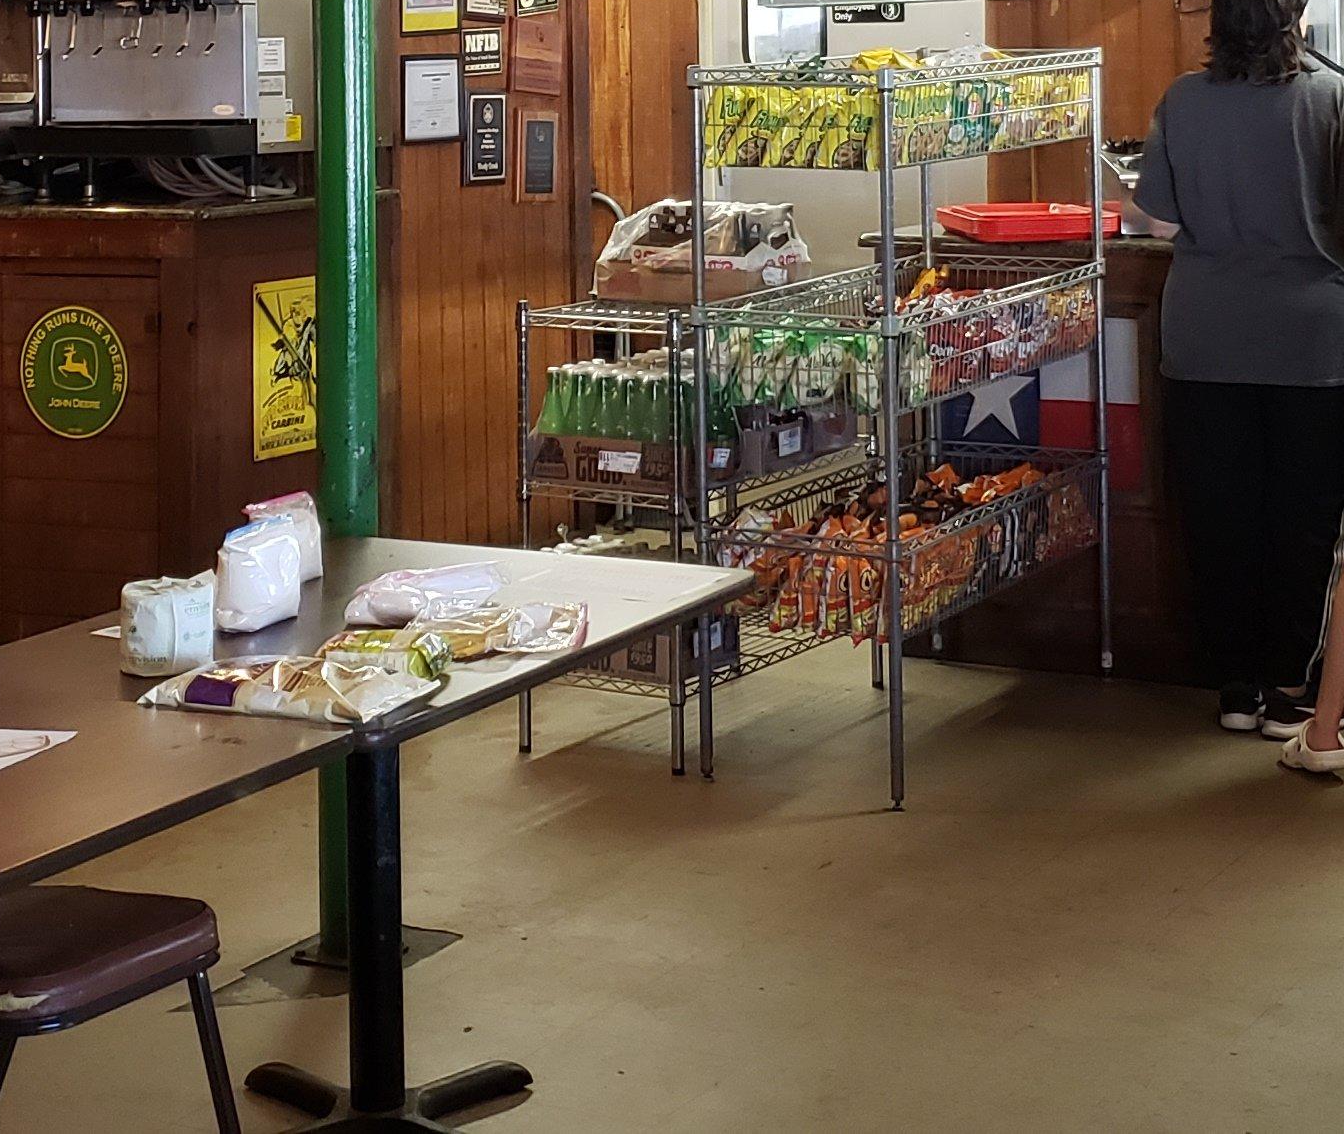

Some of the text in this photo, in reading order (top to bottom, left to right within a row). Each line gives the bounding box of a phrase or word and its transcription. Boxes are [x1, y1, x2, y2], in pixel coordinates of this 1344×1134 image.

[834, 3, 876, 13] Employees
[834, 12, 853, 22] Only
[464, 33, 499, 53] NFIB
[24, 312, 123, 393] NOTHING RUNS LIKE A DEERE
[72, 398, 101, 409] DEERE
